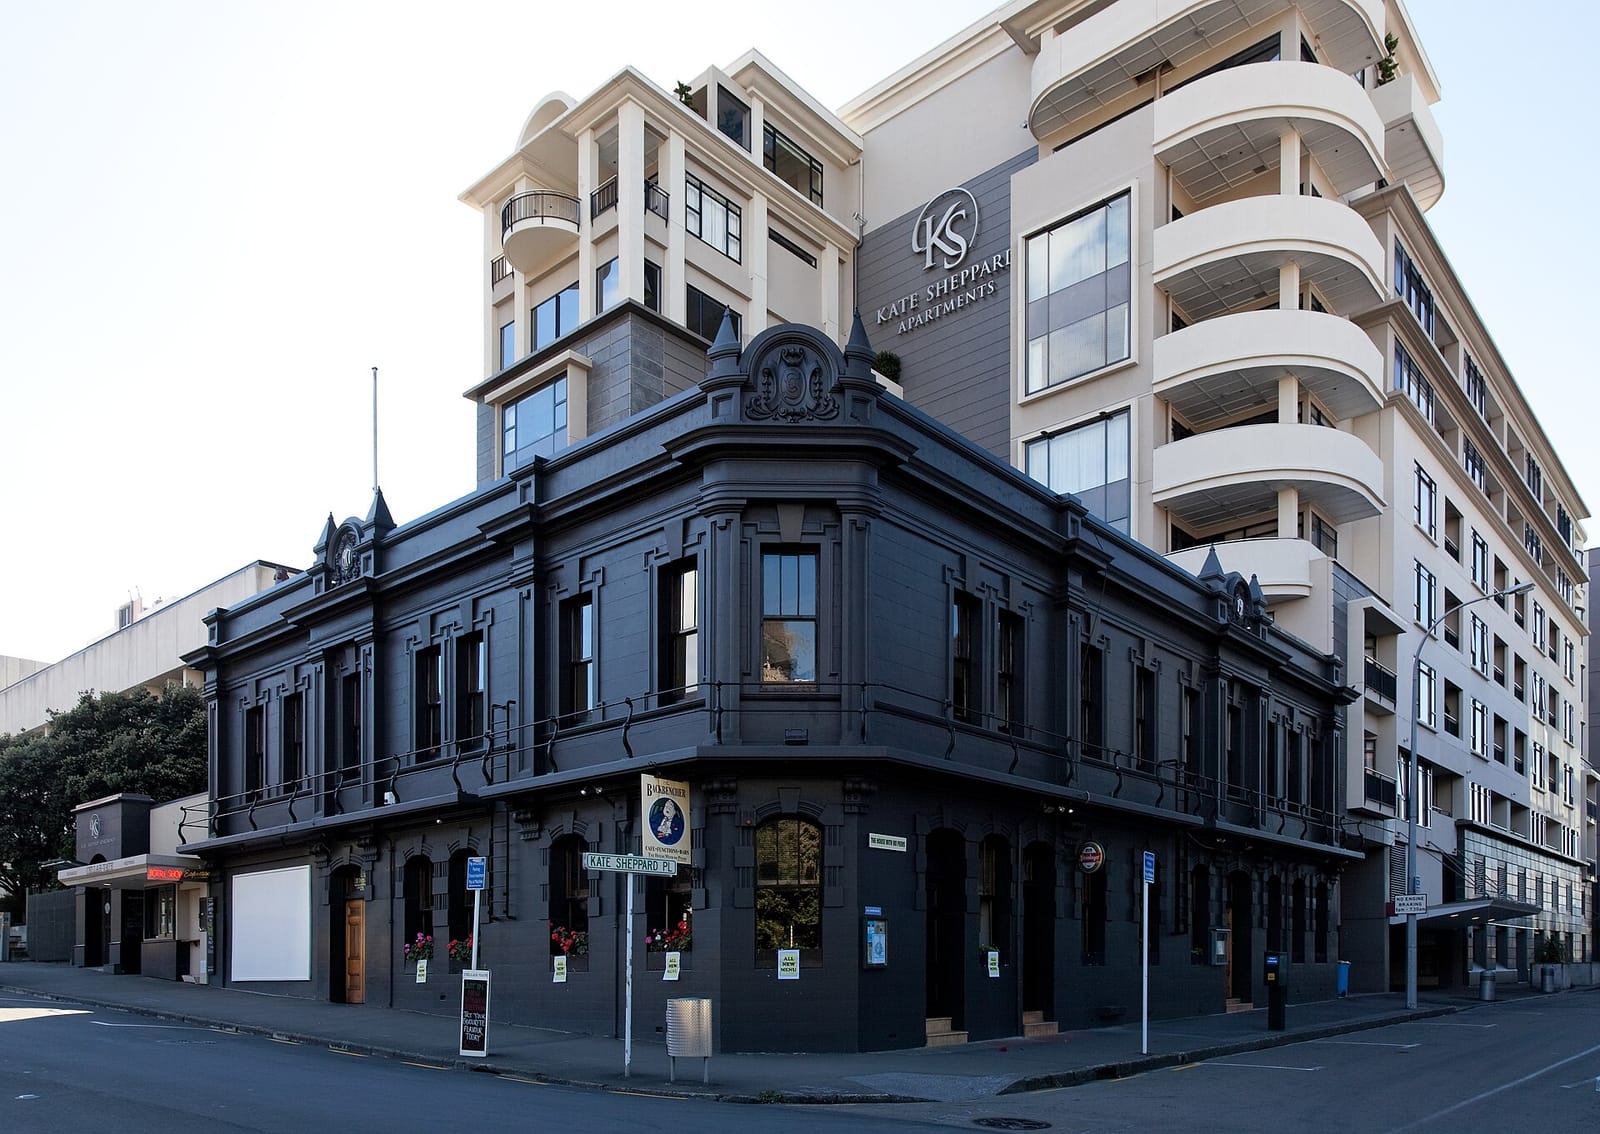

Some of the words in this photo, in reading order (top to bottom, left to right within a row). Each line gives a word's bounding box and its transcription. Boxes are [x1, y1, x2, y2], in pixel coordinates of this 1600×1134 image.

[877, 293, 918, 324] KATE
[897, 280, 995, 334] APARTMENTS
[590, 855, 611, 867] KATE
[616, 857, 659, 871] SHEPPARD
[662, 861, 673, 872] PL
